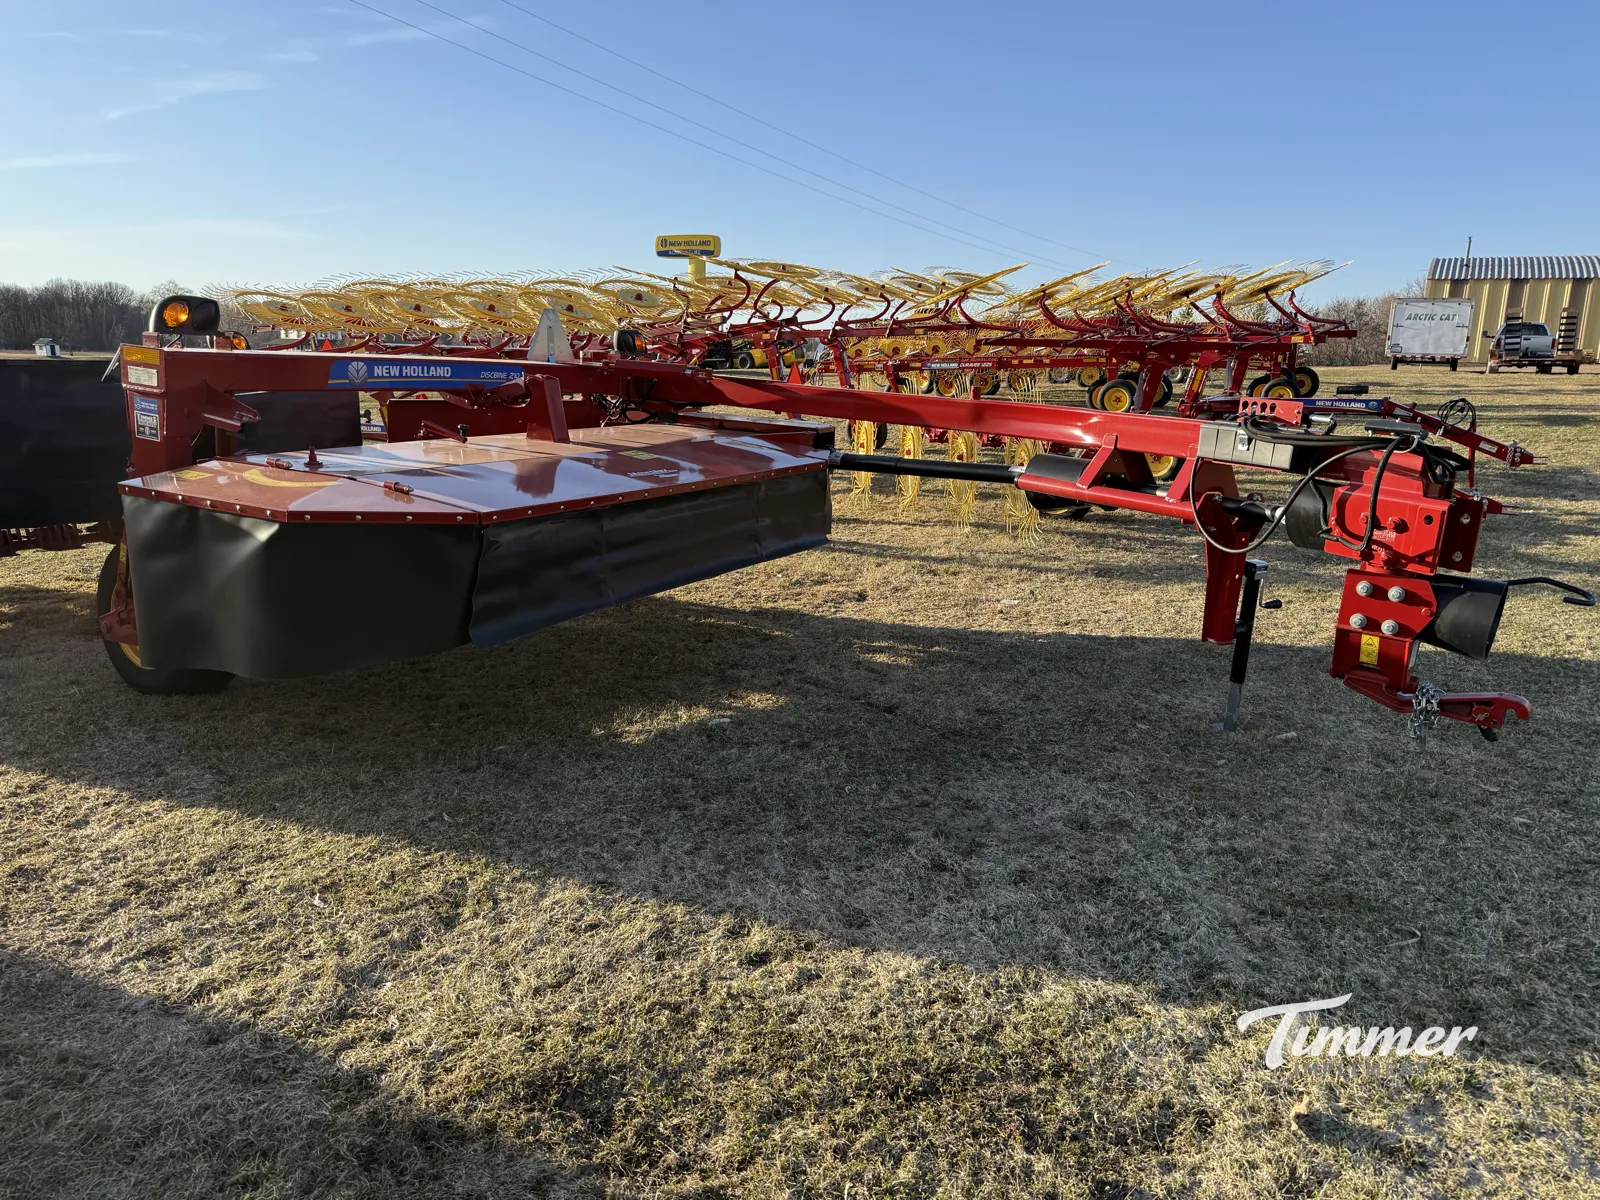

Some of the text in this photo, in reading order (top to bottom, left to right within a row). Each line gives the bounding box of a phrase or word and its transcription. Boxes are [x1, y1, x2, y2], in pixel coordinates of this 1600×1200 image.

[1405, 312, 1457, 321] ARCTIC CAT
[374, 365, 400, 377] NEW
[402, 365, 452, 377] HOLLAND
[480, 371, 508, 379] DISCBINE
[1332, 401, 1366, 409] HOLLAND
